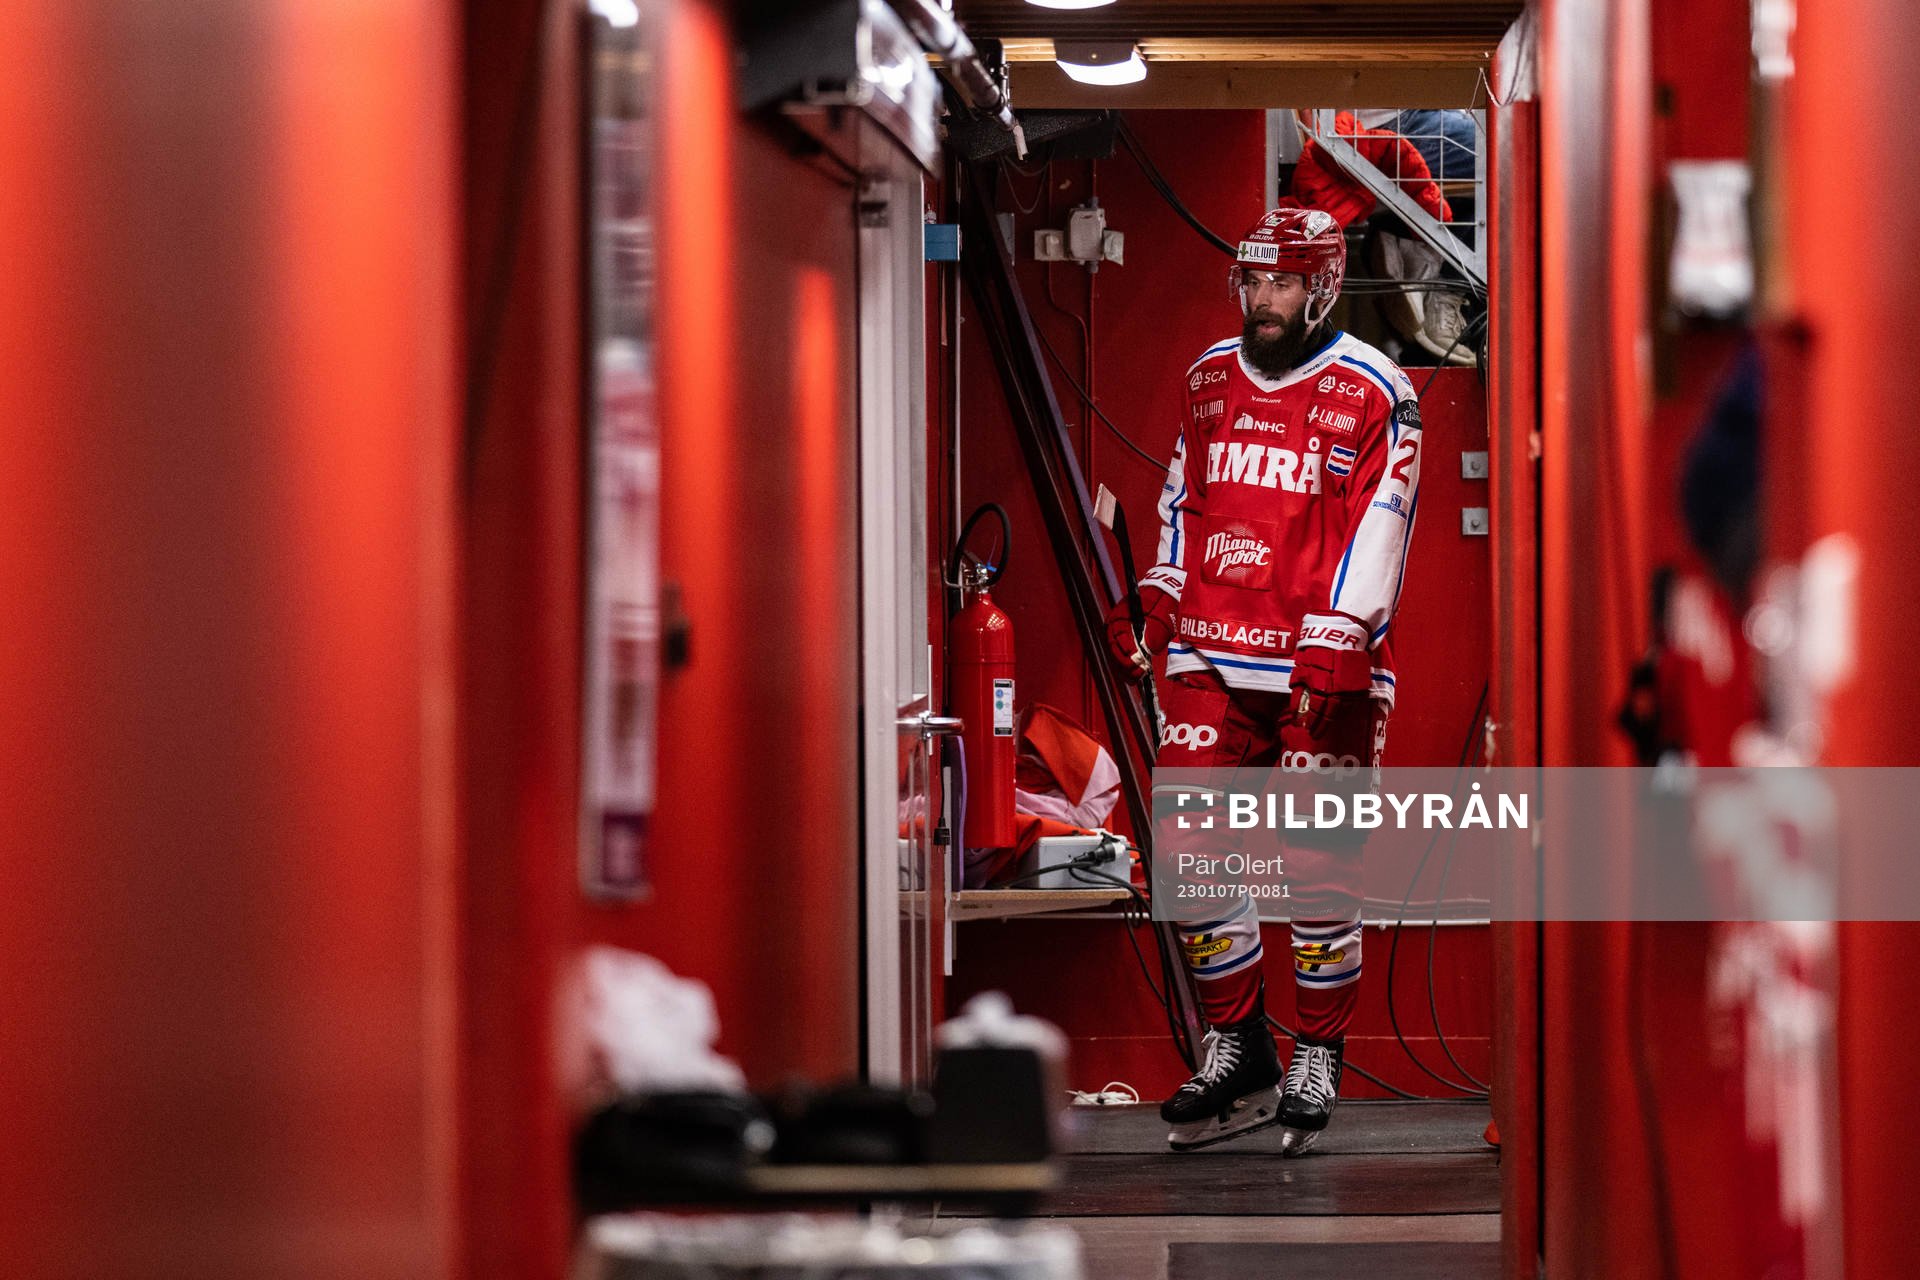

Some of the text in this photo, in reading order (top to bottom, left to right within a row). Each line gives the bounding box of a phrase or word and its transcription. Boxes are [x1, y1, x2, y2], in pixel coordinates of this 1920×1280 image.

[1249, 246, 1277, 259] LILIUM
[1204, 370, 1227, 384] SCA
[1336, 381, 1366, 400] SCA
[1200, 399, 1224, 419] LILIUM
[1318, 409, 1356, 433] LILIUM
[1253, 420, 1286, 434] NHC
[1390, 438, 1418, 488] 2
[1204, 531, 1264, 564] Miami
[1216, 547, 1271, 577] pool
[1180, 616, 1291, 649] BILBOLAGET
[1300, 626, 1361, 650] AUER
[1160, 722, 1218, 751] oop
[1281, 750, 1361, 782] coop
